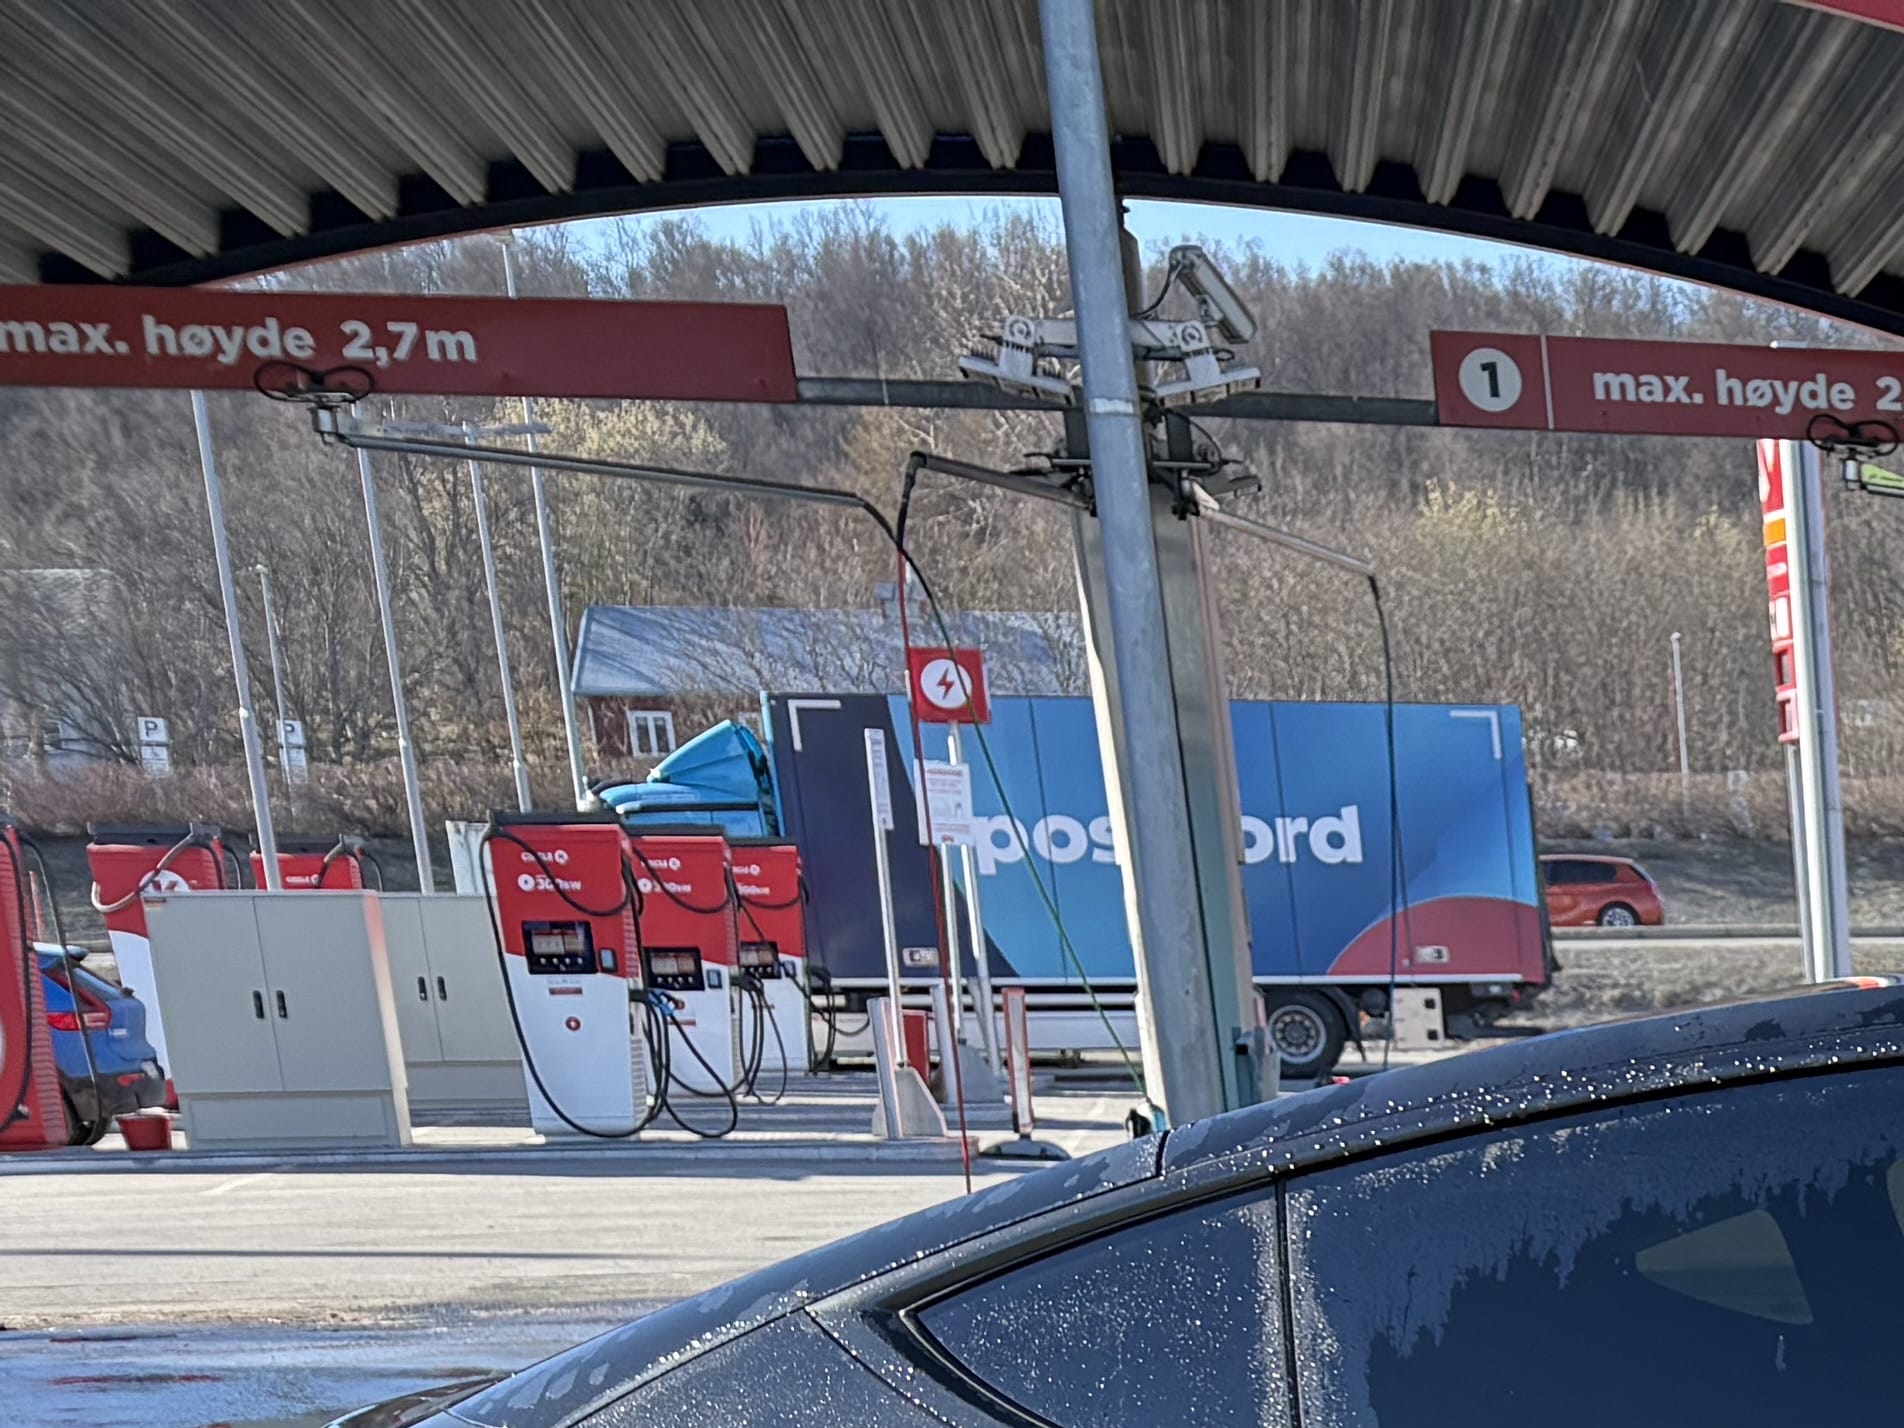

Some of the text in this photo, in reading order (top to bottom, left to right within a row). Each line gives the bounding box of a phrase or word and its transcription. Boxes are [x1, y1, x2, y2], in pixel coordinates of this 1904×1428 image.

[0, 320, 129, 354] max.
[142, 315, 315, 365] høyde
[1480, 362, 1501, 398] 1
[1594, 371, 1703, 405] max.
[1716, 369, 1855, 415] høyde
[144, 720, 158, 737] P
